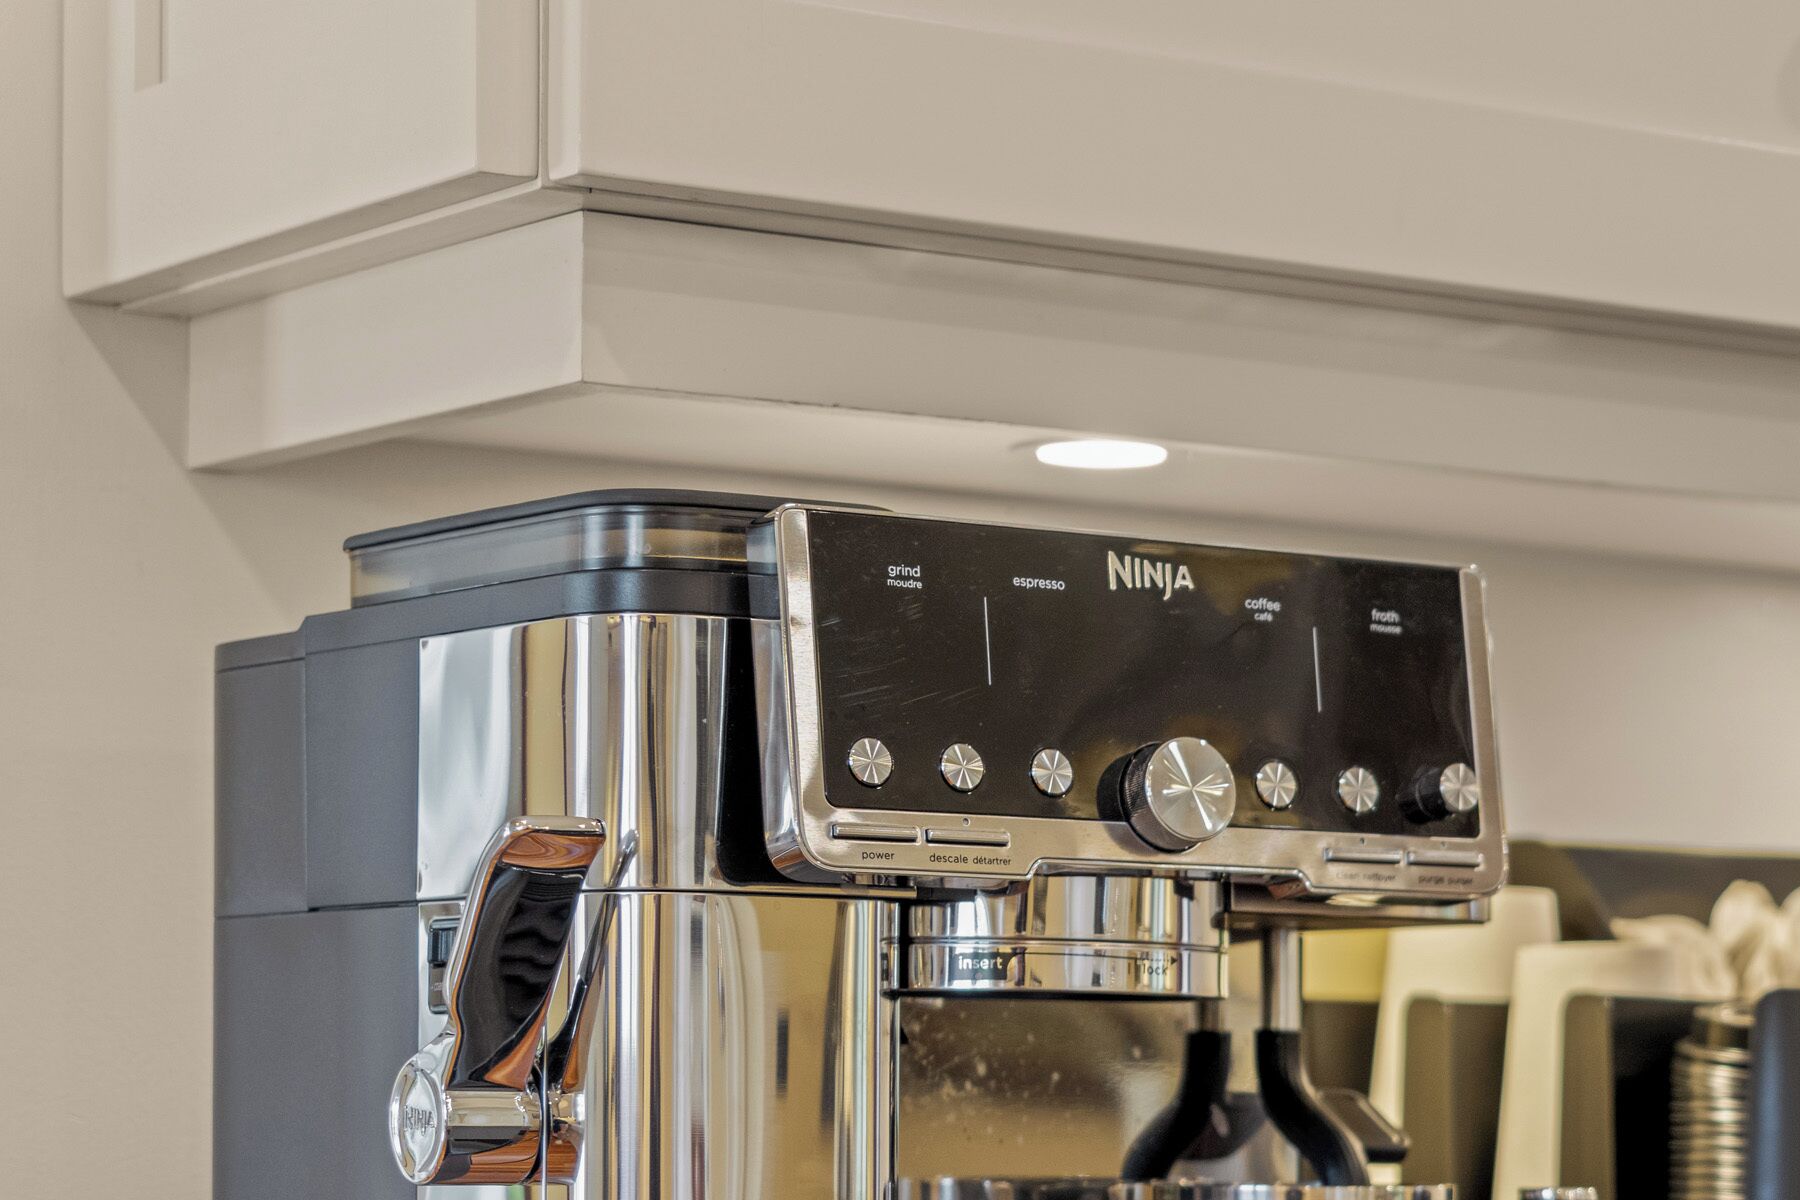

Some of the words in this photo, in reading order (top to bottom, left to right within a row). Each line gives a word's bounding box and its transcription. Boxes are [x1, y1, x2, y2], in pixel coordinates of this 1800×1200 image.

[887, 564, 921, 578] grind
[1107, 550, 1195, 601] NINJA
[886, 577, 923, 589] moudre
[1012, 576, 1066, 591] espresso
[1244, 597, 1281, 612] coffee
[1253, 611, 1273, 622] café
[1371, 608, 1400, 623] froth
[861, 850, 895, 861] power
[929, 852, 969, 864] descale
[972, 855, 1012, 866] détartrer
[958, 955, 1003, 970] insert
[1142, 962, 1169, 976] lock
[403, 1104, 437, 1136] NINJA
